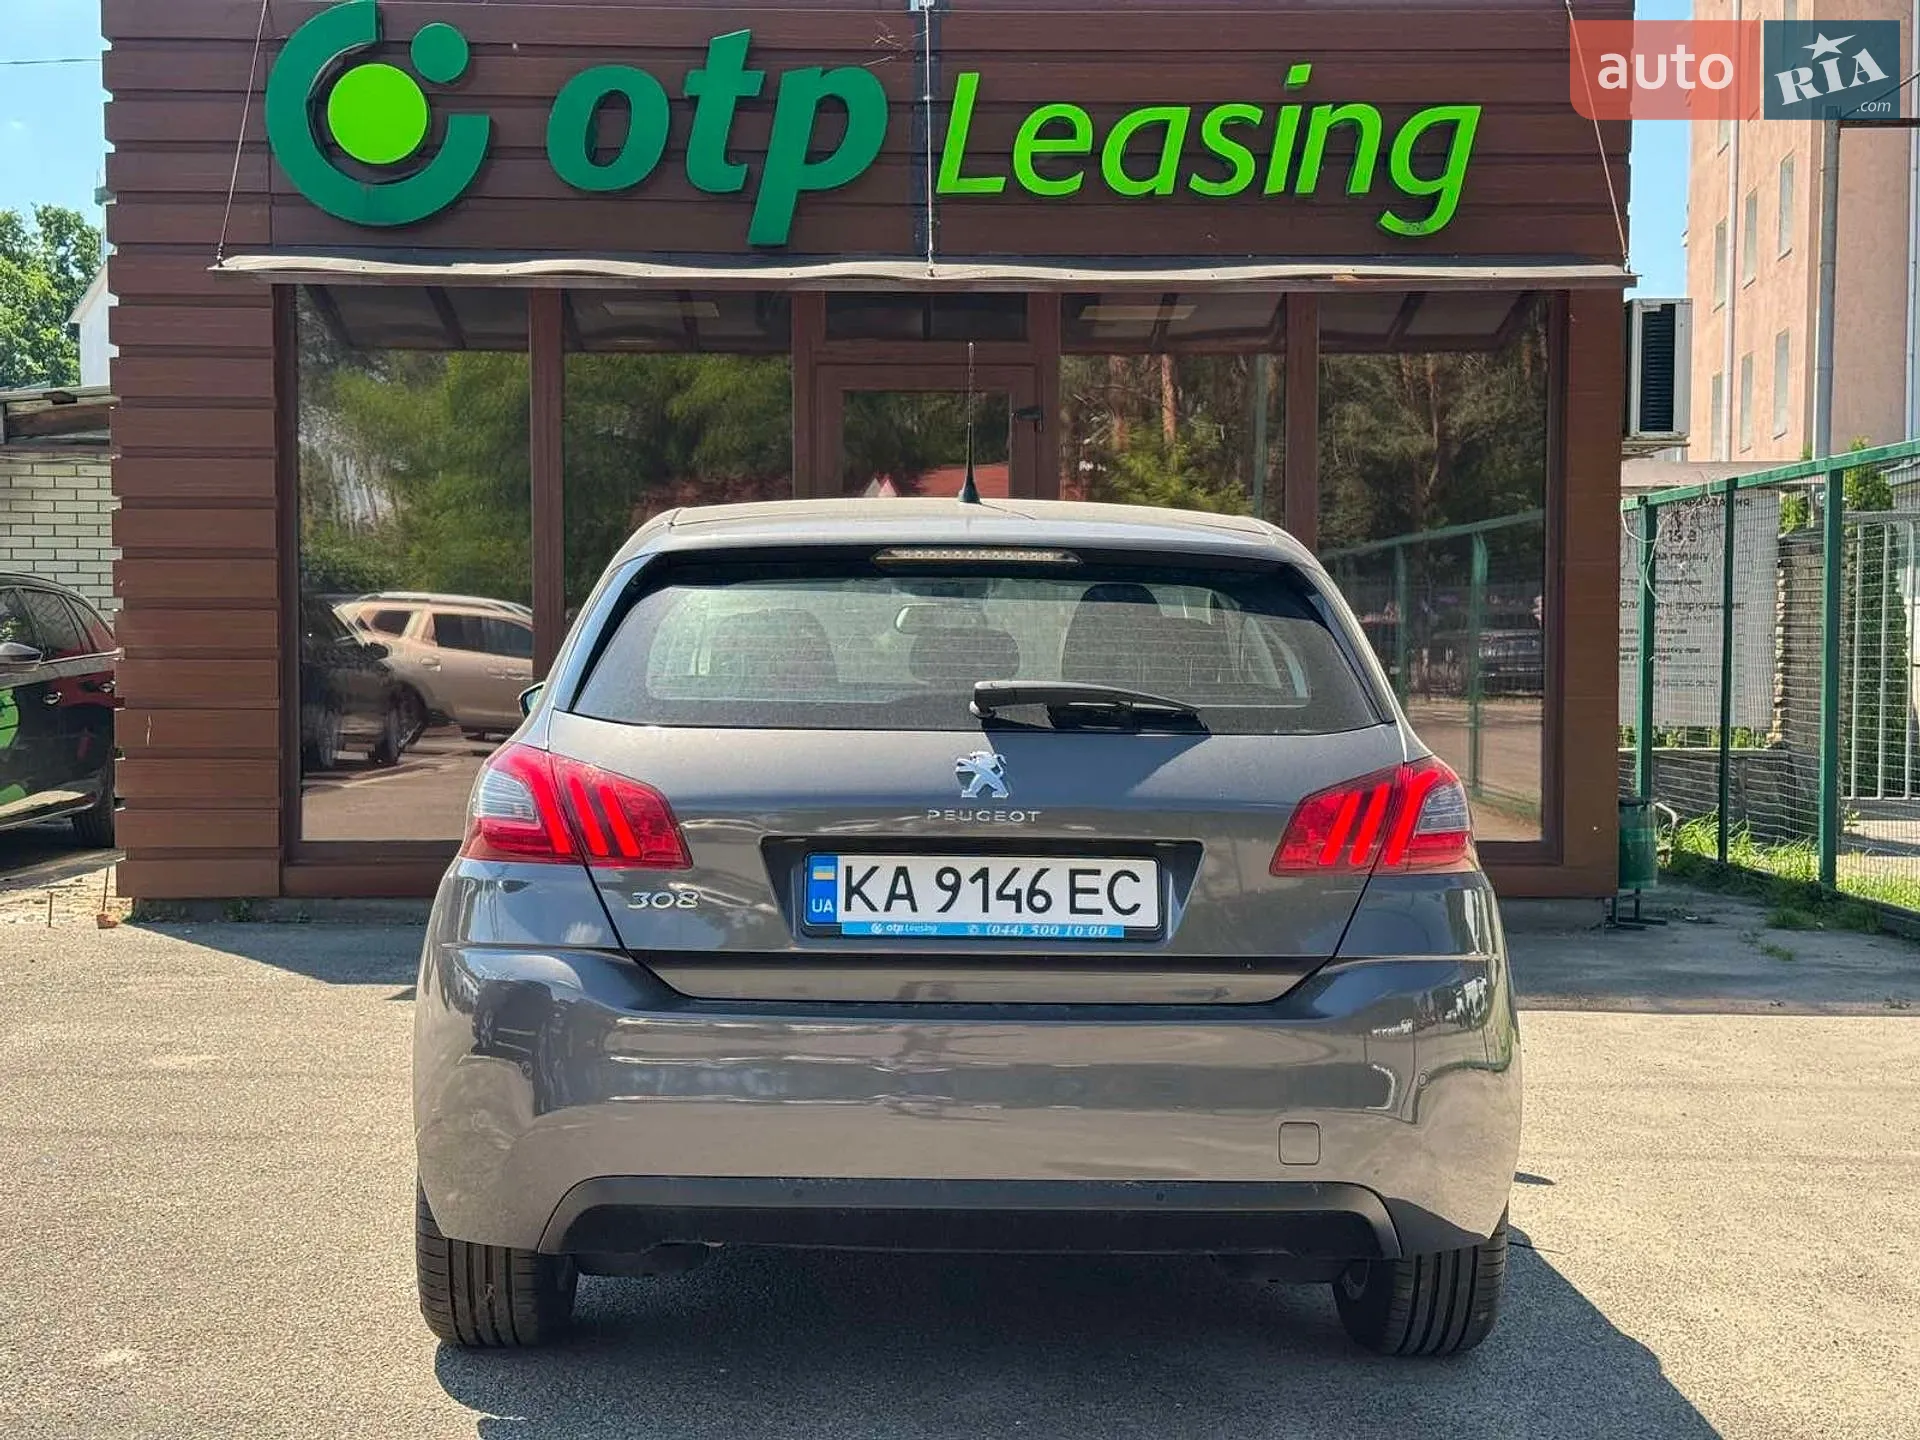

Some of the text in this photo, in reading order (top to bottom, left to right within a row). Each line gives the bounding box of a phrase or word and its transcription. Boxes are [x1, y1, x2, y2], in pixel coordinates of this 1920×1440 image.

[546, 29, 1481, 246] otp Leasing
[926, 809, 1041, 822] PEUGEOT
[844, 865, 1142, 916] KA 9146 EC
[627, 892, 699, 909] 308
[812, 900, 834, 914] UA
[1031, 925, 1059, 937] 500
